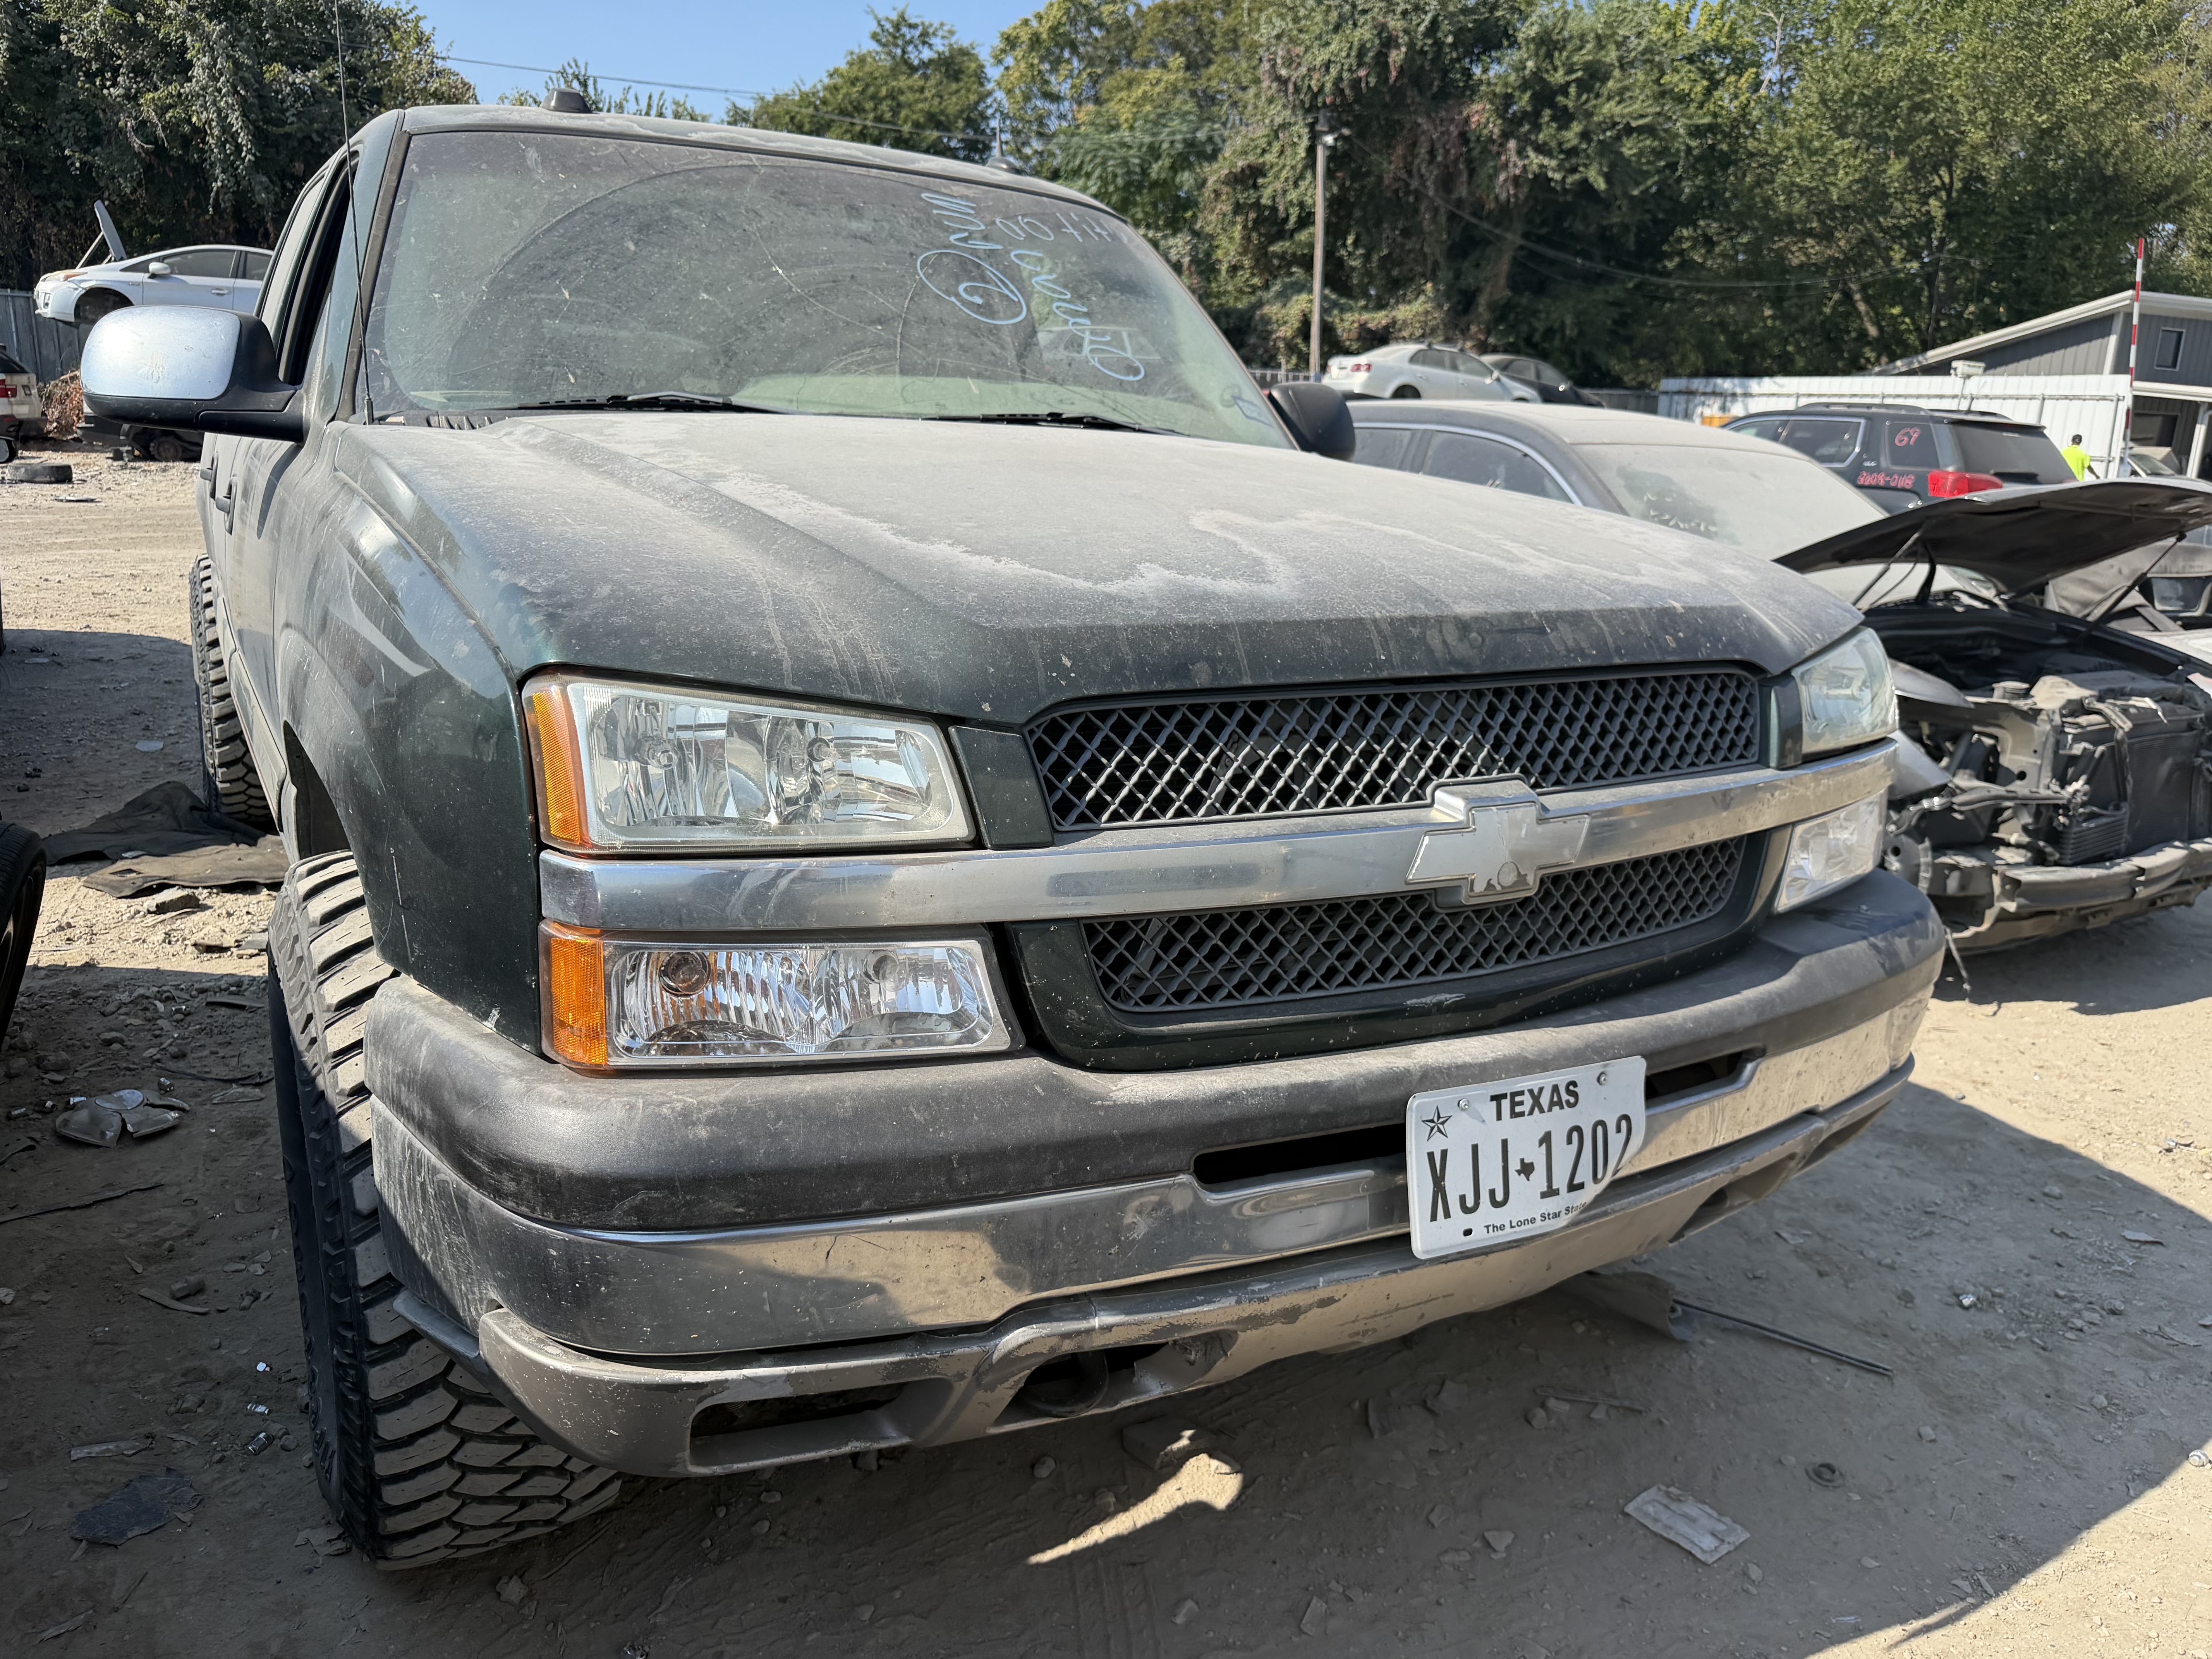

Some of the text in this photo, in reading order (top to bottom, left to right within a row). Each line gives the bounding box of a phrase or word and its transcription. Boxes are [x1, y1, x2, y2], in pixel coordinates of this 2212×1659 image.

[1490, 1080, 1579, 1121] TEXAS
[1484, 1201, 1587, 1233] The Lone Star State
